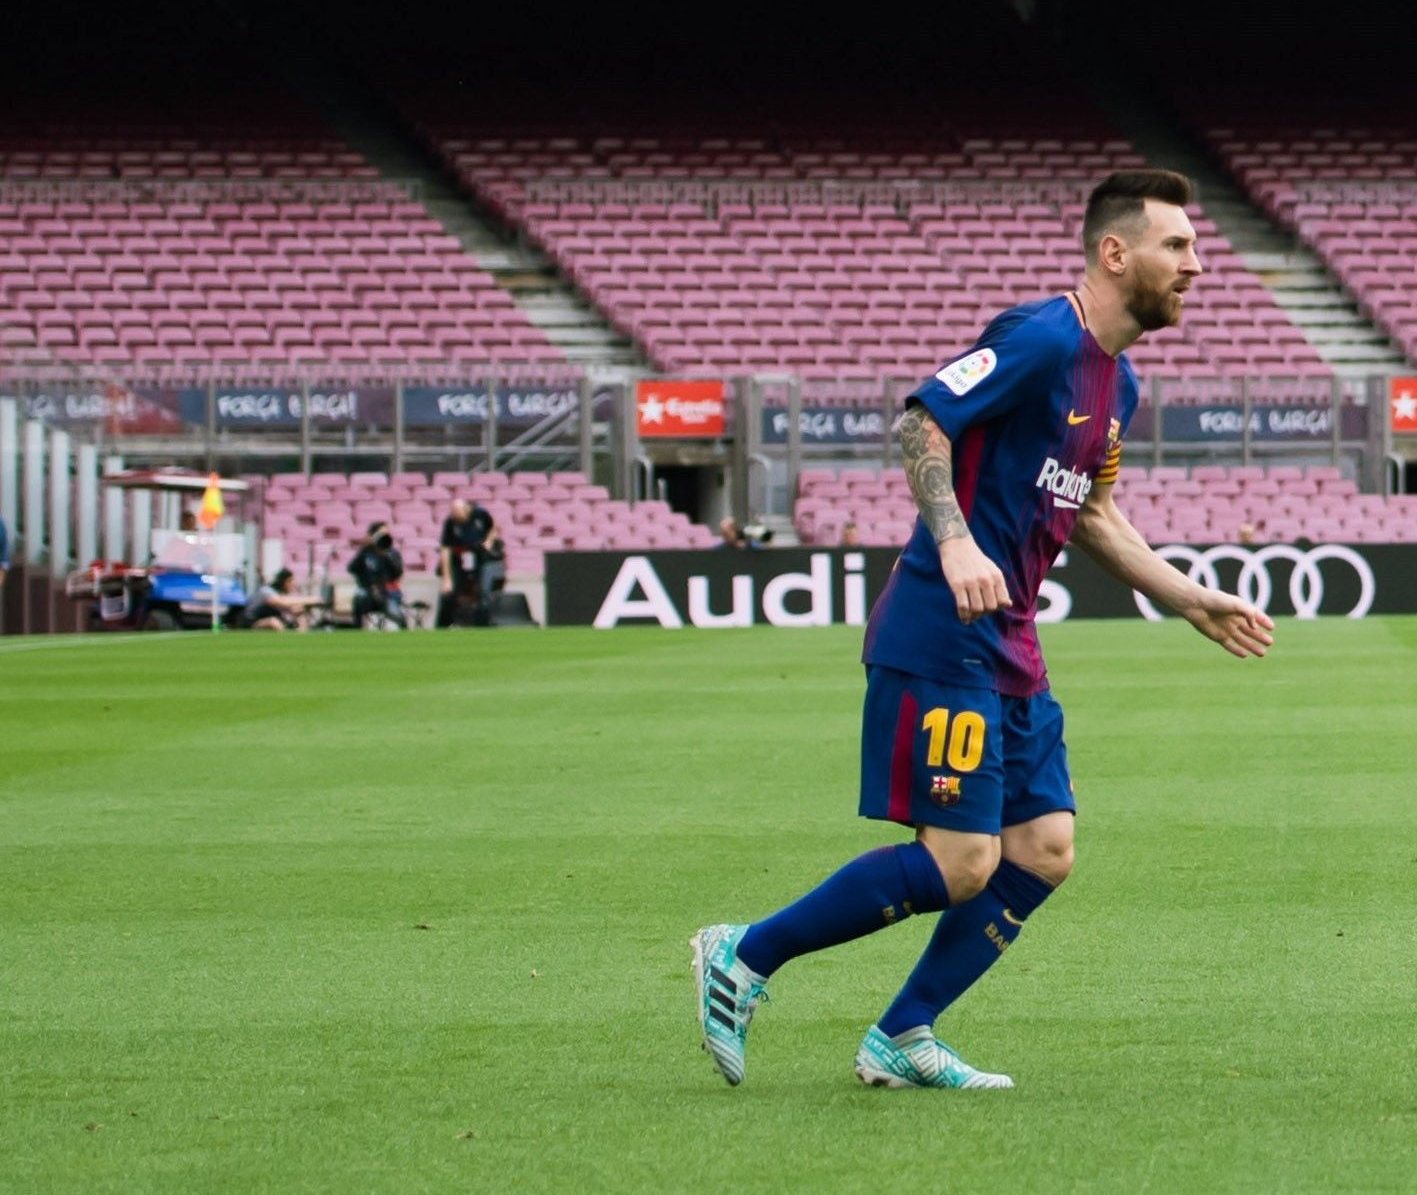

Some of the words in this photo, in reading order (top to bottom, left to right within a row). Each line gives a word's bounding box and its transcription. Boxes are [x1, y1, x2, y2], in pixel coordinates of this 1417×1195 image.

[1035, 456, 1092, 505] Rakute
[592, 553, 866, 630] Audi
[922, 707, 986, 773] 10
